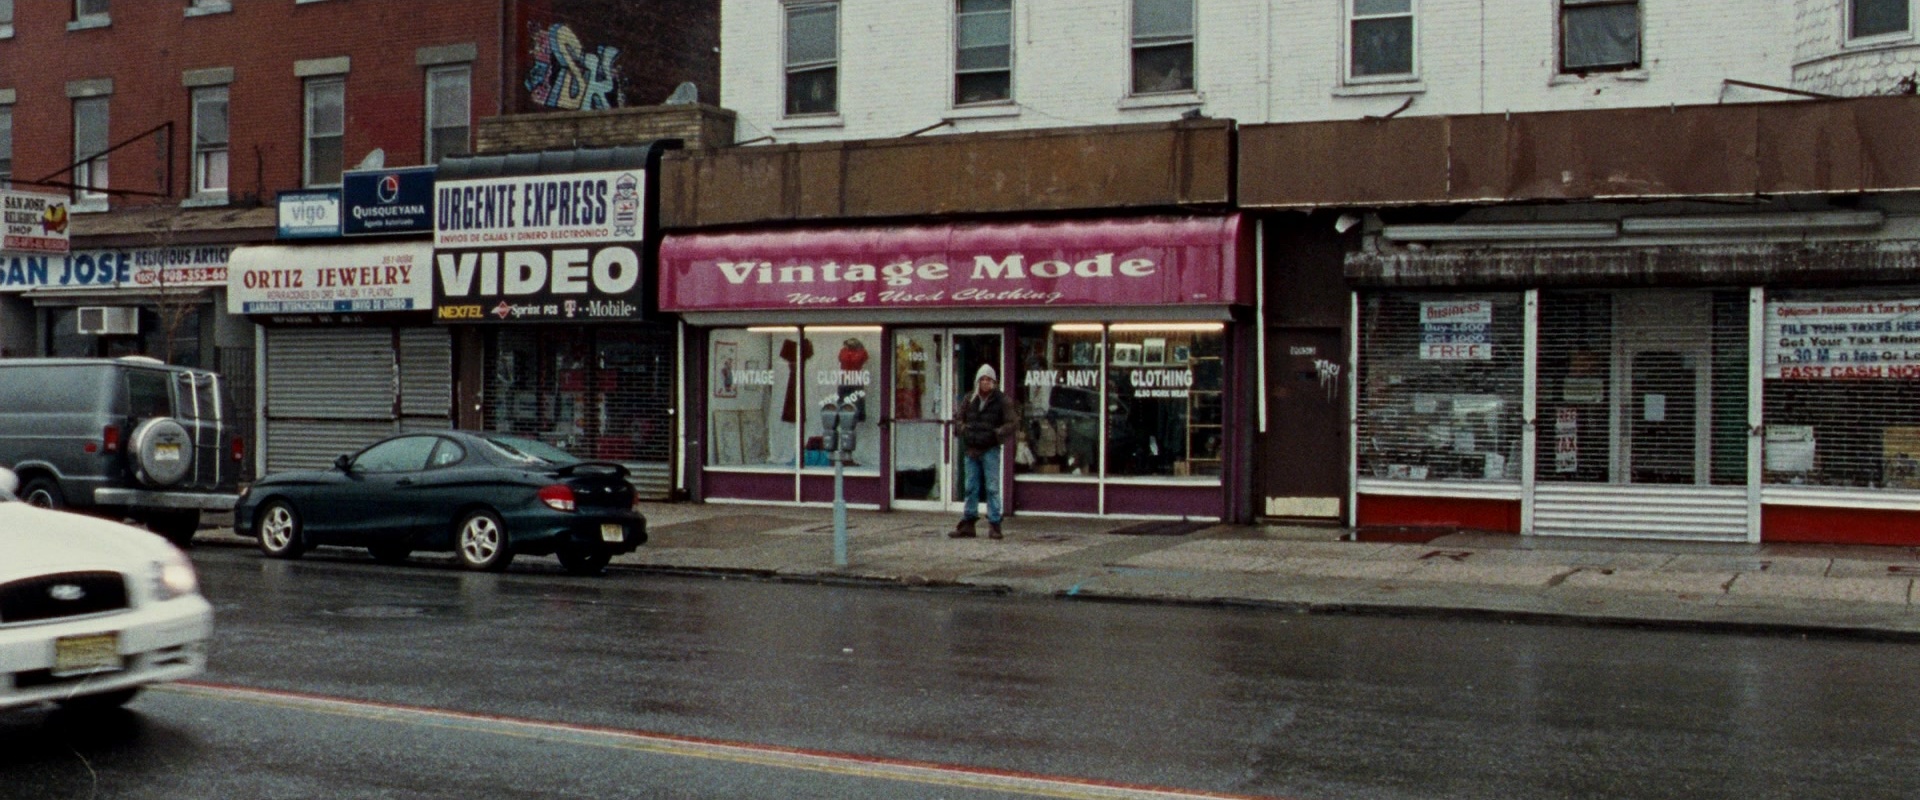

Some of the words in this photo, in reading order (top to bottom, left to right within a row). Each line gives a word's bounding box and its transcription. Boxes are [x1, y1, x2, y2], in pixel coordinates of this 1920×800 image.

[438, 184, 516, 231] URGENTE
[523, 179, 608, 227] EXPRESS
[292, 202, 326, 226] vigo
[8, 225, 33, 234] SHOP
[440, 233, 468, 244] ENVIOS
[469, 233, 480, 243] DE
[482, 231, 508, 242] CAJAS
[510, 231, 516, 241] Y
[517, 230, 548, 242] DINERO
[550, 228, 609, 240] ELECTRONICO
[135, 248, 192, 266] RELIGIOUS
[59, 253, 131, 285] JOSE
[243, 269, 304, 289] ORTIZ
[316, 264, 413, 288] JEWELRY
[436, 246, 639, 297] VIDEO
[716, 260, 950, 286] Vintage
[970, 252, 1156, 280] Mode
[787, 292, 839, 304] New
[848, 291, 867, 303] &
[878, 290, 945, 303] Used
[951, 287, 1065, 304] Clothing
[438, 304, 484, 319] NEXTEL
[511, 303, 541, 320] Sprint
[543, 304, 559, 316] PCS
[1426, 302, 1481, 319] Business
[1424, 323, 1448, 333] Buy
[1781, 324, 1808, 335] FILE
[1810, 323, 1847, 334] YOUR
[1850, 321, 1892, 333] TAXES
[1429, 344, 1481, 357] FREE
[1780, 338, 1805, 348] Get
[1810, 337, 1841, 347] Your
[1847, 336, 1873, 345] Tax
[1793, 348, 1812, 362] 30
[731, 369, 775, 386] VINTAGE
[817, 369, 871, 386] CLOTHING
[1024, 369, 1058, 387] ARMY
[1066, 369, 1099, 387] NAVY
[1131, 369, 1193, 387] CLOTHING
[1780, 365, 1825, 379] FAST
[1830, 364, 1882, 379] CASH
[1134, 390, 1151, 398] ALSO
[1151, 390, 1170, 398] WORK
[1171, 389, 1189, 398] WEAR
